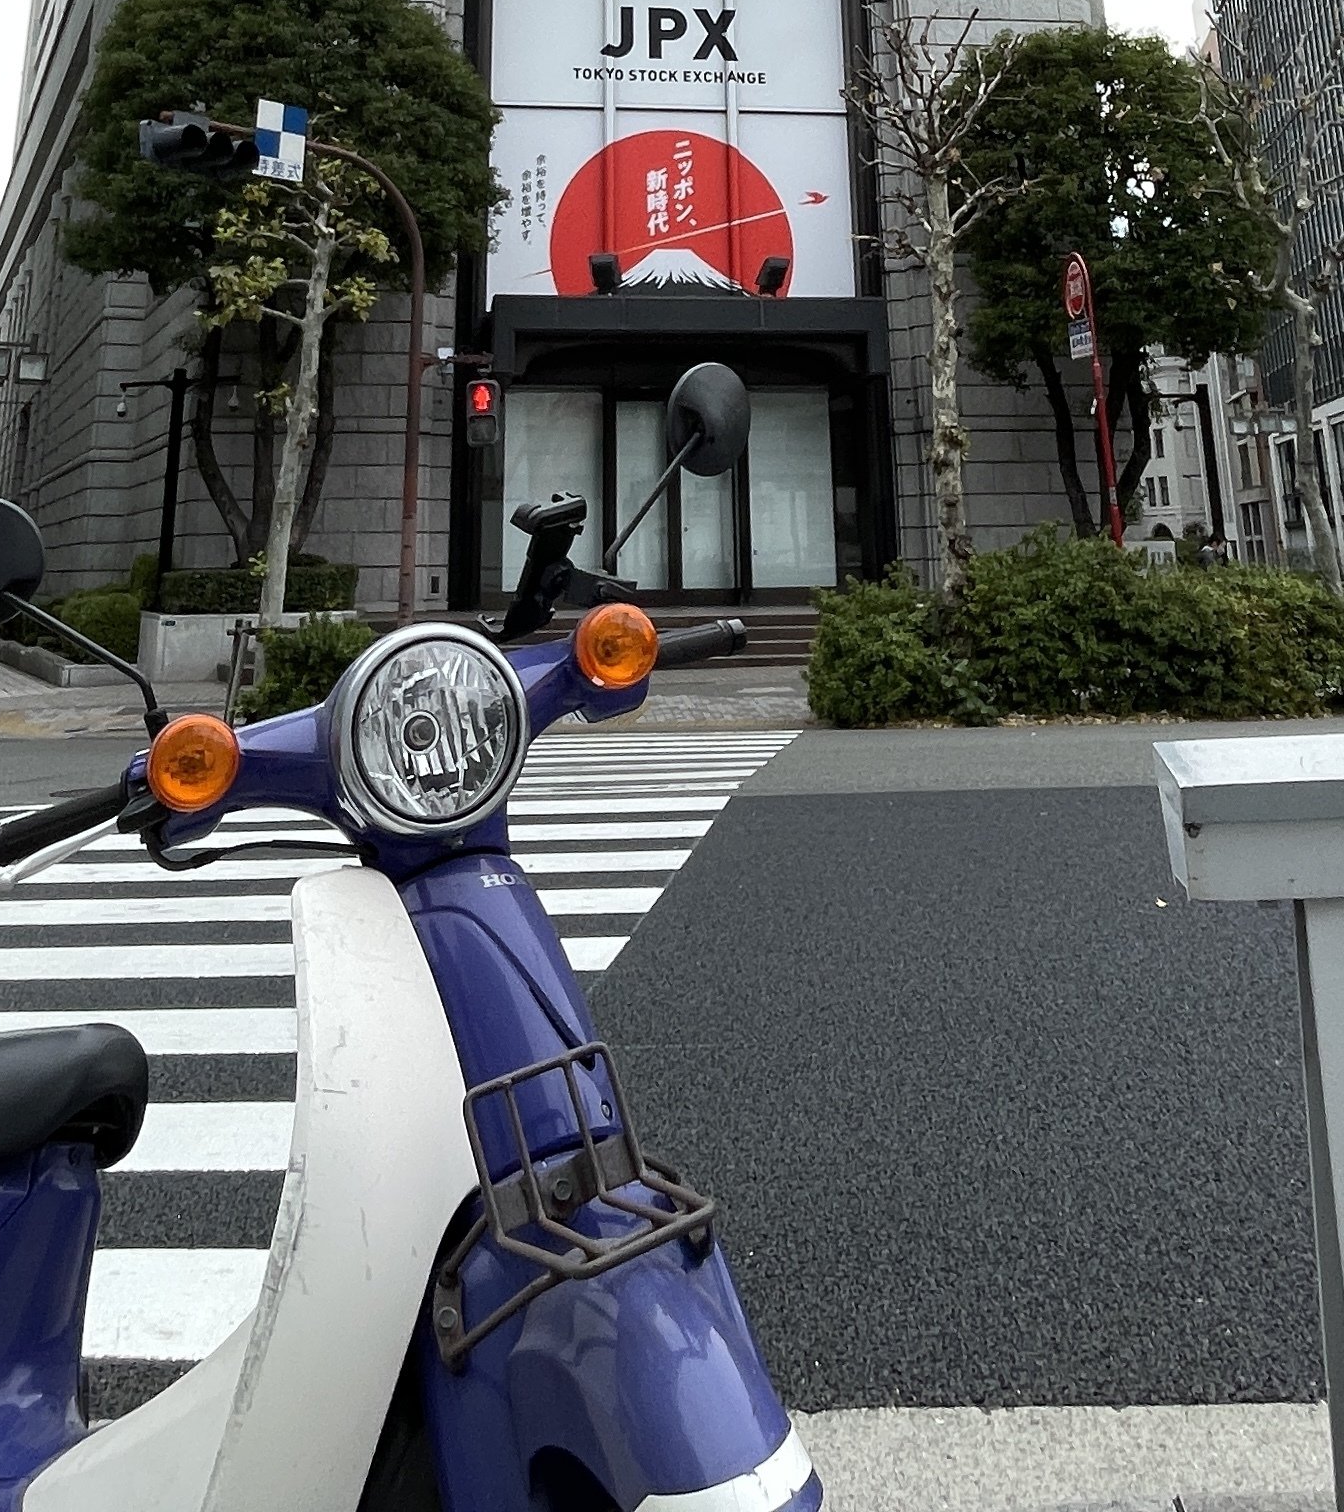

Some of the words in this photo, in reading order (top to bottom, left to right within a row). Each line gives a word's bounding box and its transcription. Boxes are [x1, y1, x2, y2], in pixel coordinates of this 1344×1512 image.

[600, 6, 739, 61] JPX
[573, 67, 624, 81] TOKYO
[629, 69, 678, 83] STOCK
[683, 70, 767, 85] EXCHANGE
[645, 167, 670, 237] 新時代
